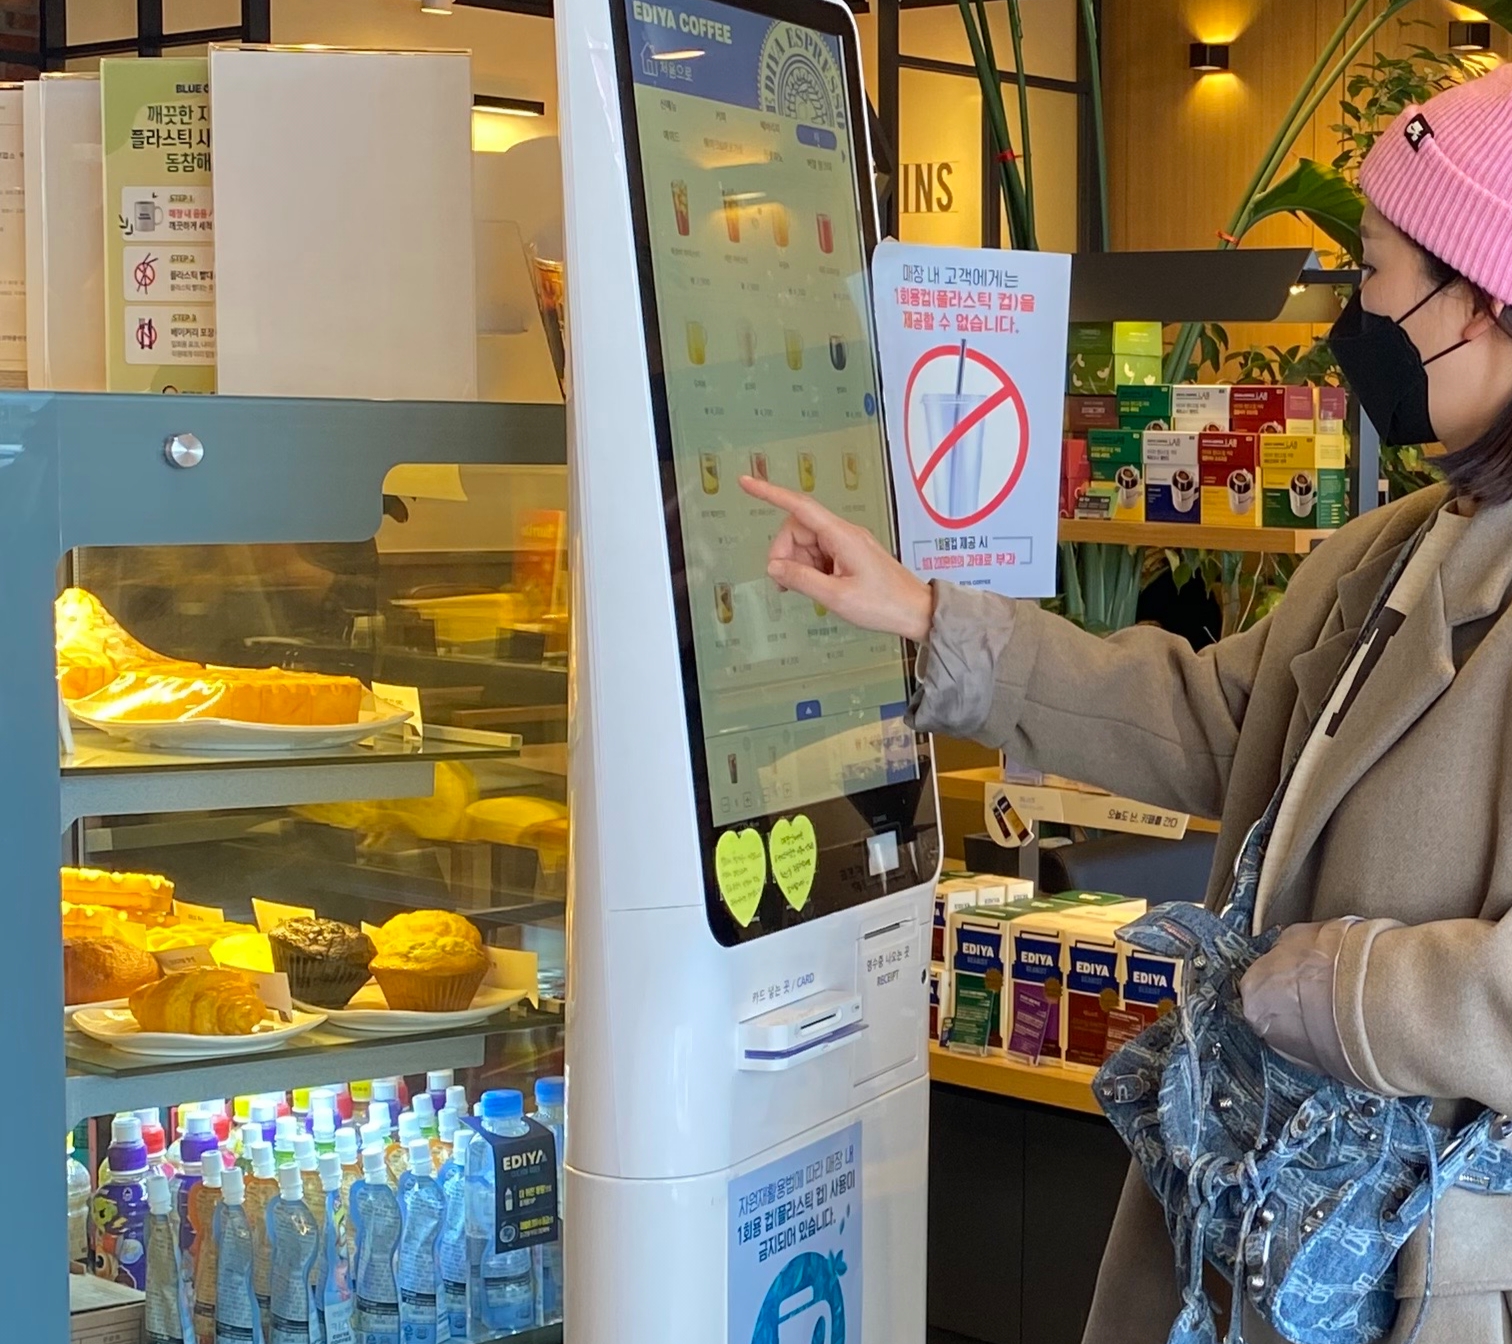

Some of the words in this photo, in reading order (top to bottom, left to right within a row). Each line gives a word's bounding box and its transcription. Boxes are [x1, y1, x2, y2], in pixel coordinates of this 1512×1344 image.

[632, 0, 676, 30] EDIYA
[679, 11, 733, 45] COFFEE
[176, 83, 202, 93] BLUE
[147, 105, 194, 125] 깨끗한
[131, 128, 193, 149] 플라스틱
[165, 152, 211, 172] 동참해
[171, 270, 198, 281] 플라스틱
[902, 263, 924, 284] 매장
[927, 265, 940, 284] 내
[944, 266, 1019, 289] 고객에게는
[894, 287, 991, 309] 1회용컵(플라스틱
[997, 292, 1035, 312] 컵)을
[903, 310, 934, 331] 제공할
[938, 312, 950, 332] 수
[956, 313, 1019, 335] 없습니다.
[960, 536, 975, 550] 제공
[979, 536, 988, 548] 시
[996, 552, 1016, 566] 부과
[962, 942, 994, 958] EDIYA
[1021, 951, 1053, 967] EDIYA
[877, 969, 900, 986] RECEIPT
[1076, 961, 1109, 977] EDIYA
[1133, 971, 1167, 987] EDIYA
[752, 990, 765, 1004] 카드
[796, 972, 815, 988] CARD
[502, 1149, 547, 1171] EDIYA
[739, 1169, 804, 1217] 자원재활용법에
[806, 1159, 824, 1184] 따라
[737, 1216, 761, 1246] 1회용
[765, 1189, 814, 1233] 컵(플라스틱
[830, 1169, 855, 1199] 사용이
[759, 1225, 796, 1263] 금지되어
[799, 1206, 836, 1243] 있습니다.
